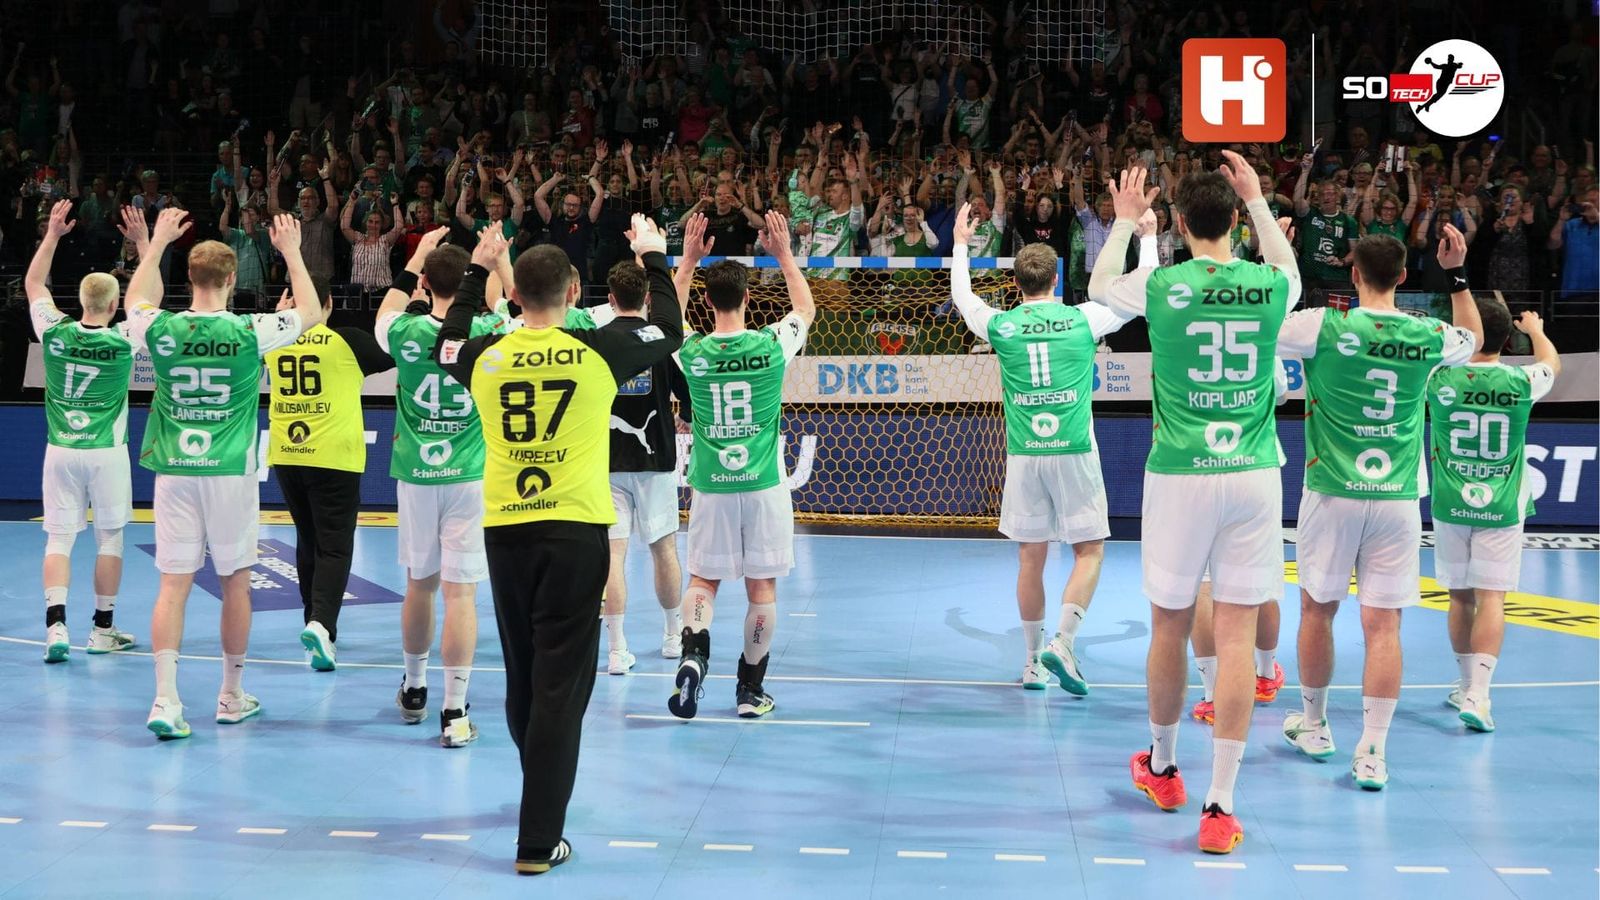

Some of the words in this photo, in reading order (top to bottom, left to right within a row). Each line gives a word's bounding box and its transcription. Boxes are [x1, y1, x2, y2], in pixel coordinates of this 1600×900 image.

[1202, 284, 1273, 305] zolar
[1022, 319, 1074, 335] zolar
[293, 333, 332, 345] olar
[69, 347, 120, 360] zolar
[181, 340, 241, 357] zolar
[1186, 321, 1261, 383] 35
[1366, 340, 1431, 361] zolar
[512, 347, 588, 368] zolar
[715, 354, 772, 373] zolar
[1026, 342, 1051, 388] 11
[1106, 361, 1126, 370] Das
[64, 362, 101, 399] 17
[278, 355, 322, 396] 96
[817, 363, 900, 395] DKB
[1106, 372, 1130, 381] kann
[169, 366, 231, 405] 25
[904, 385, 929, 395] Bank
[1106, 383, 1131, 392] Bank
[412, 373, 473, 419] 43
[1013, 389, 1078, 406] ANDERSSON
[1188, 389, 1257, 409] KOPLJAR
[1362, 368, 1398, 420] 3
[1462, 389, 1521, 407] zolar
[274, 402, 331, 414] MILOSAVLJEV
[500, 379, 578, 442] 87
[709, 381, 752, 426] 18
[170, 405, 234, 421] LANGHOFF
[418, 419, 468, 433] JACOBS
[57, 430, 97, 440] Schindler
[1449, 411, 1510, 460] 20
[281, 445, 316, 454] Schindler
[1025, 439, 1071, 449] Schindler
[167, 457, 221, 467] Schindler
[1193, 454, 1257, 469] Schindler
[412, 467, 463, 479] Schindler
[710, 473, 760, 483] Schindler
[1345, 481, 1404, 492] Schindler
[1450, 507, 1504, 521] Schindler
